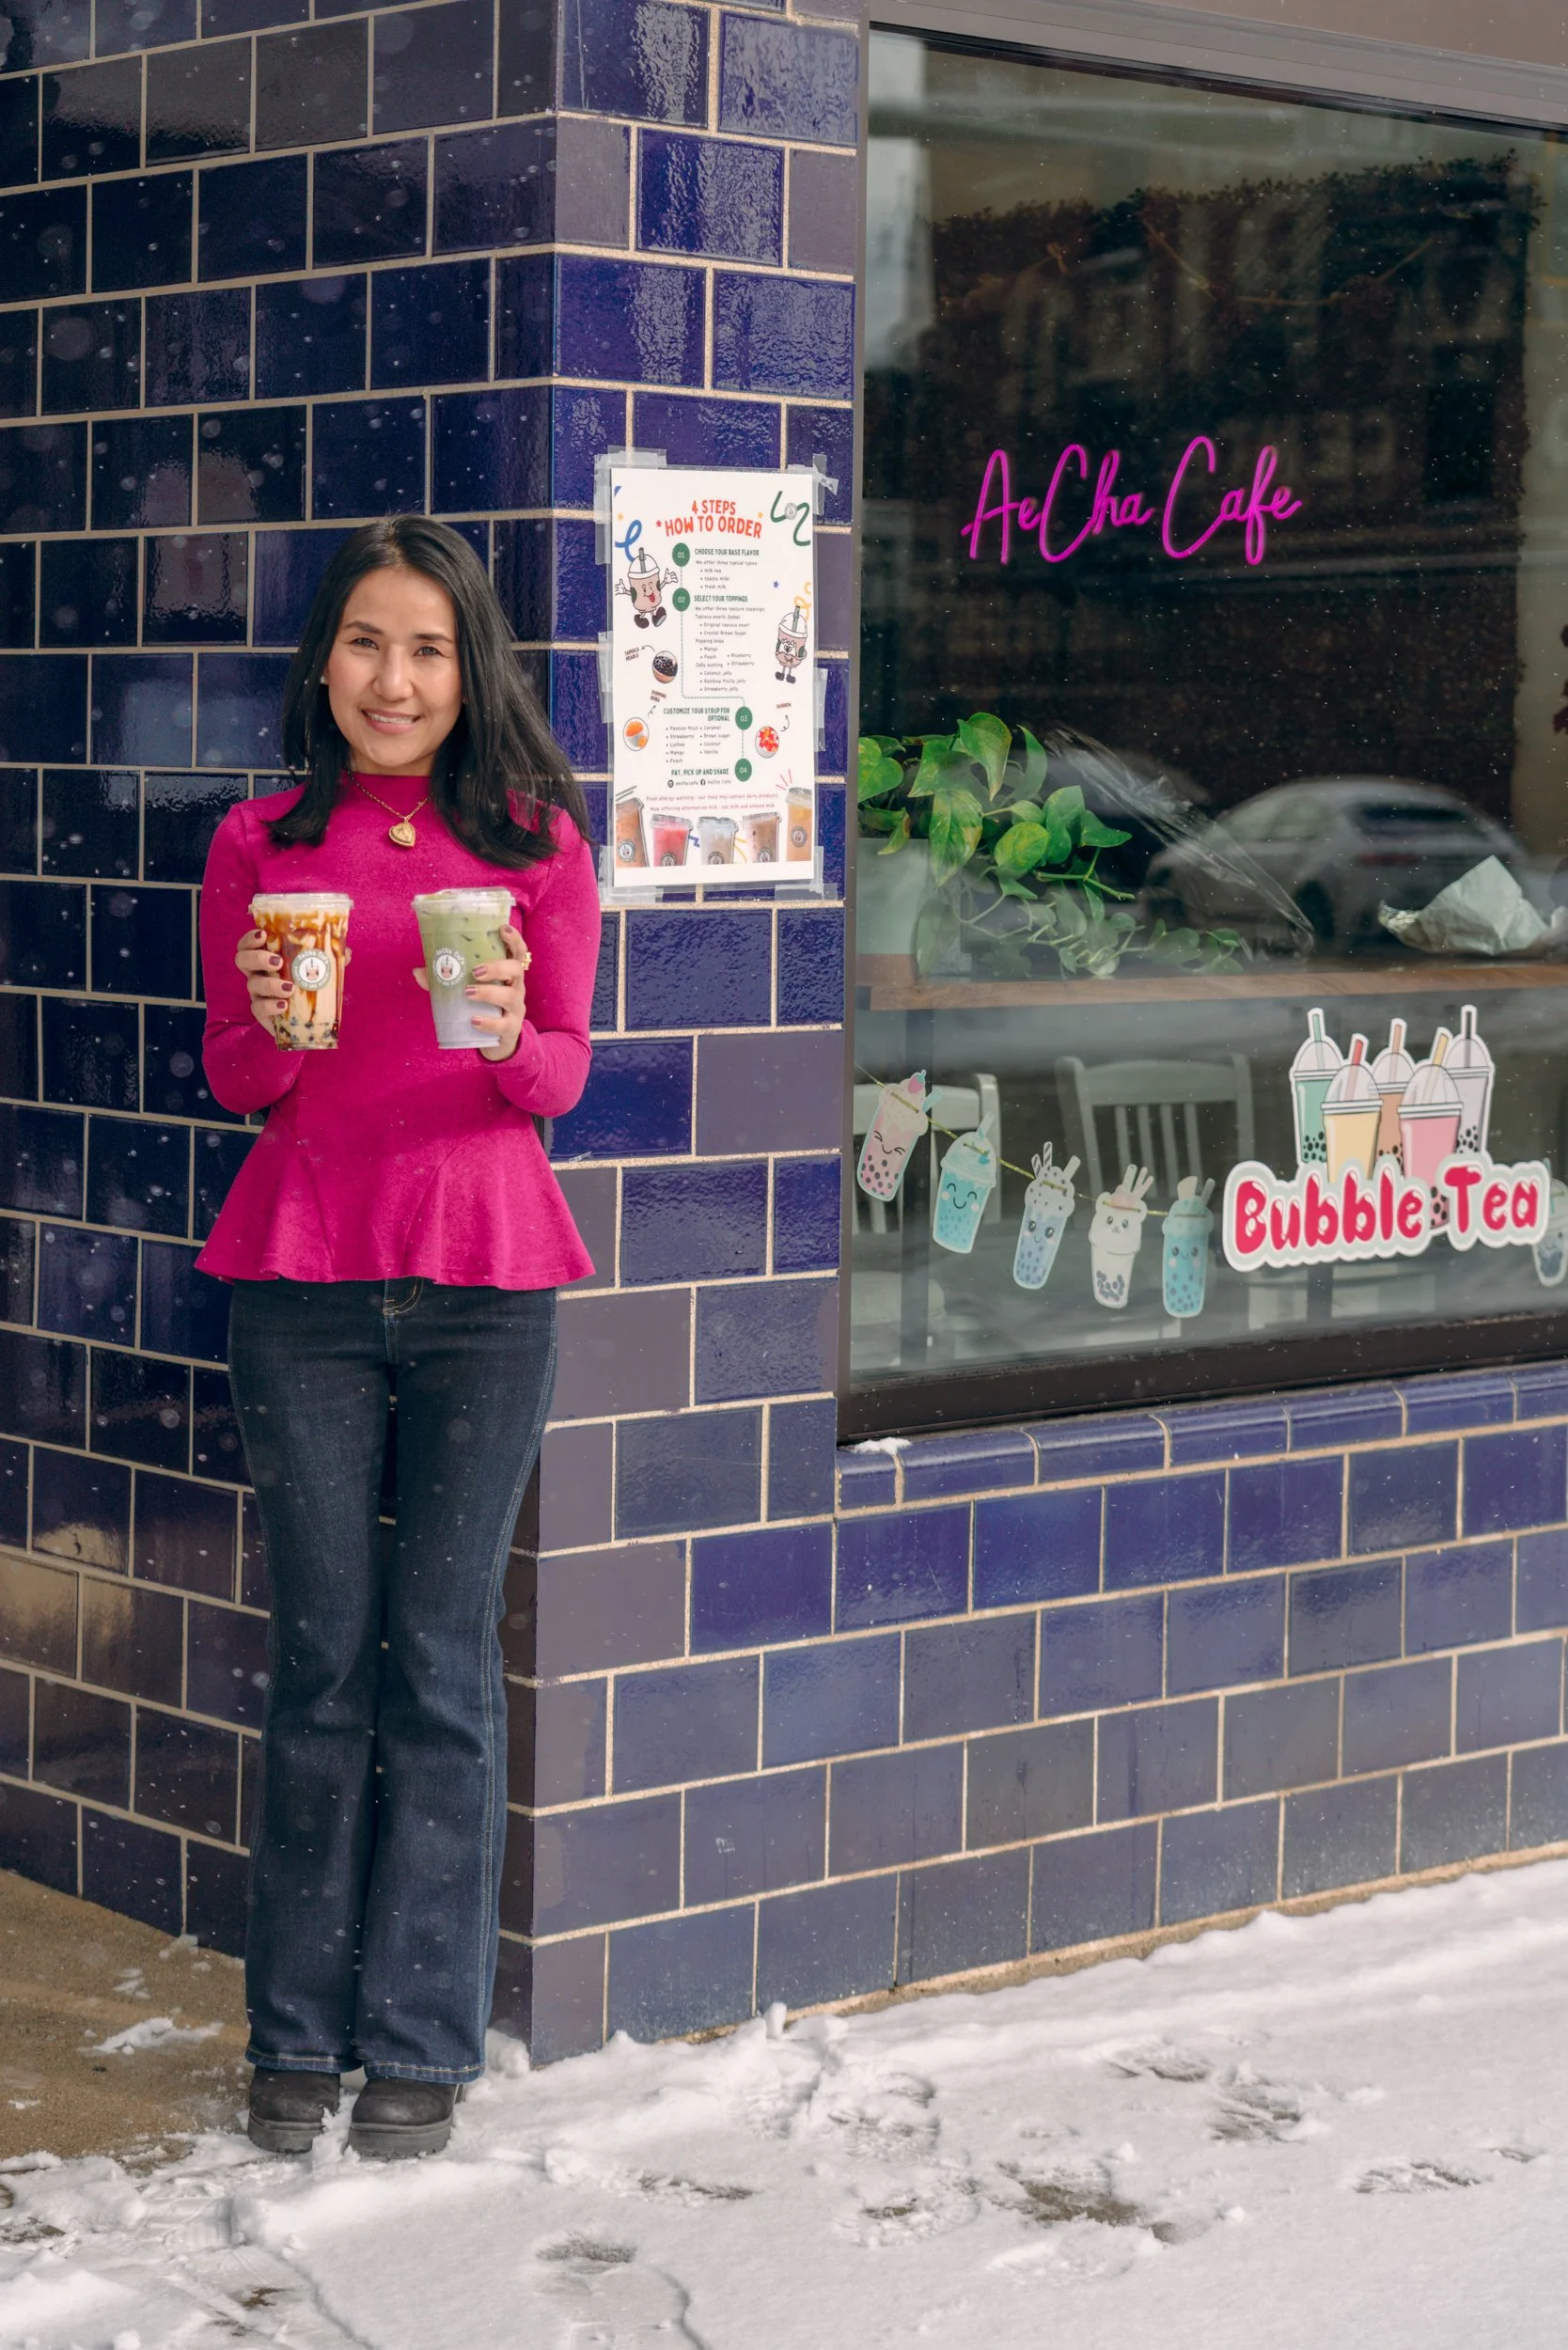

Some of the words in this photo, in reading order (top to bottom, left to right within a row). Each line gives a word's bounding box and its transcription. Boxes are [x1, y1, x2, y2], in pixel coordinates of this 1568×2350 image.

[665, 516, 694, 537] HOW
[698, 515, 714, 532] TO
[718, 515, 762, 539] ORDER
[692, 500, 698, 514] 4
[702, 499, 736, 515] STEPS
[960, 443, 1155, 565] AeCha
[1162, 435, 1303, 566] Cafe
[1235, 1167, 1423, 1254] Bubble
[1443, 1165, 1539, 1233] Tea
